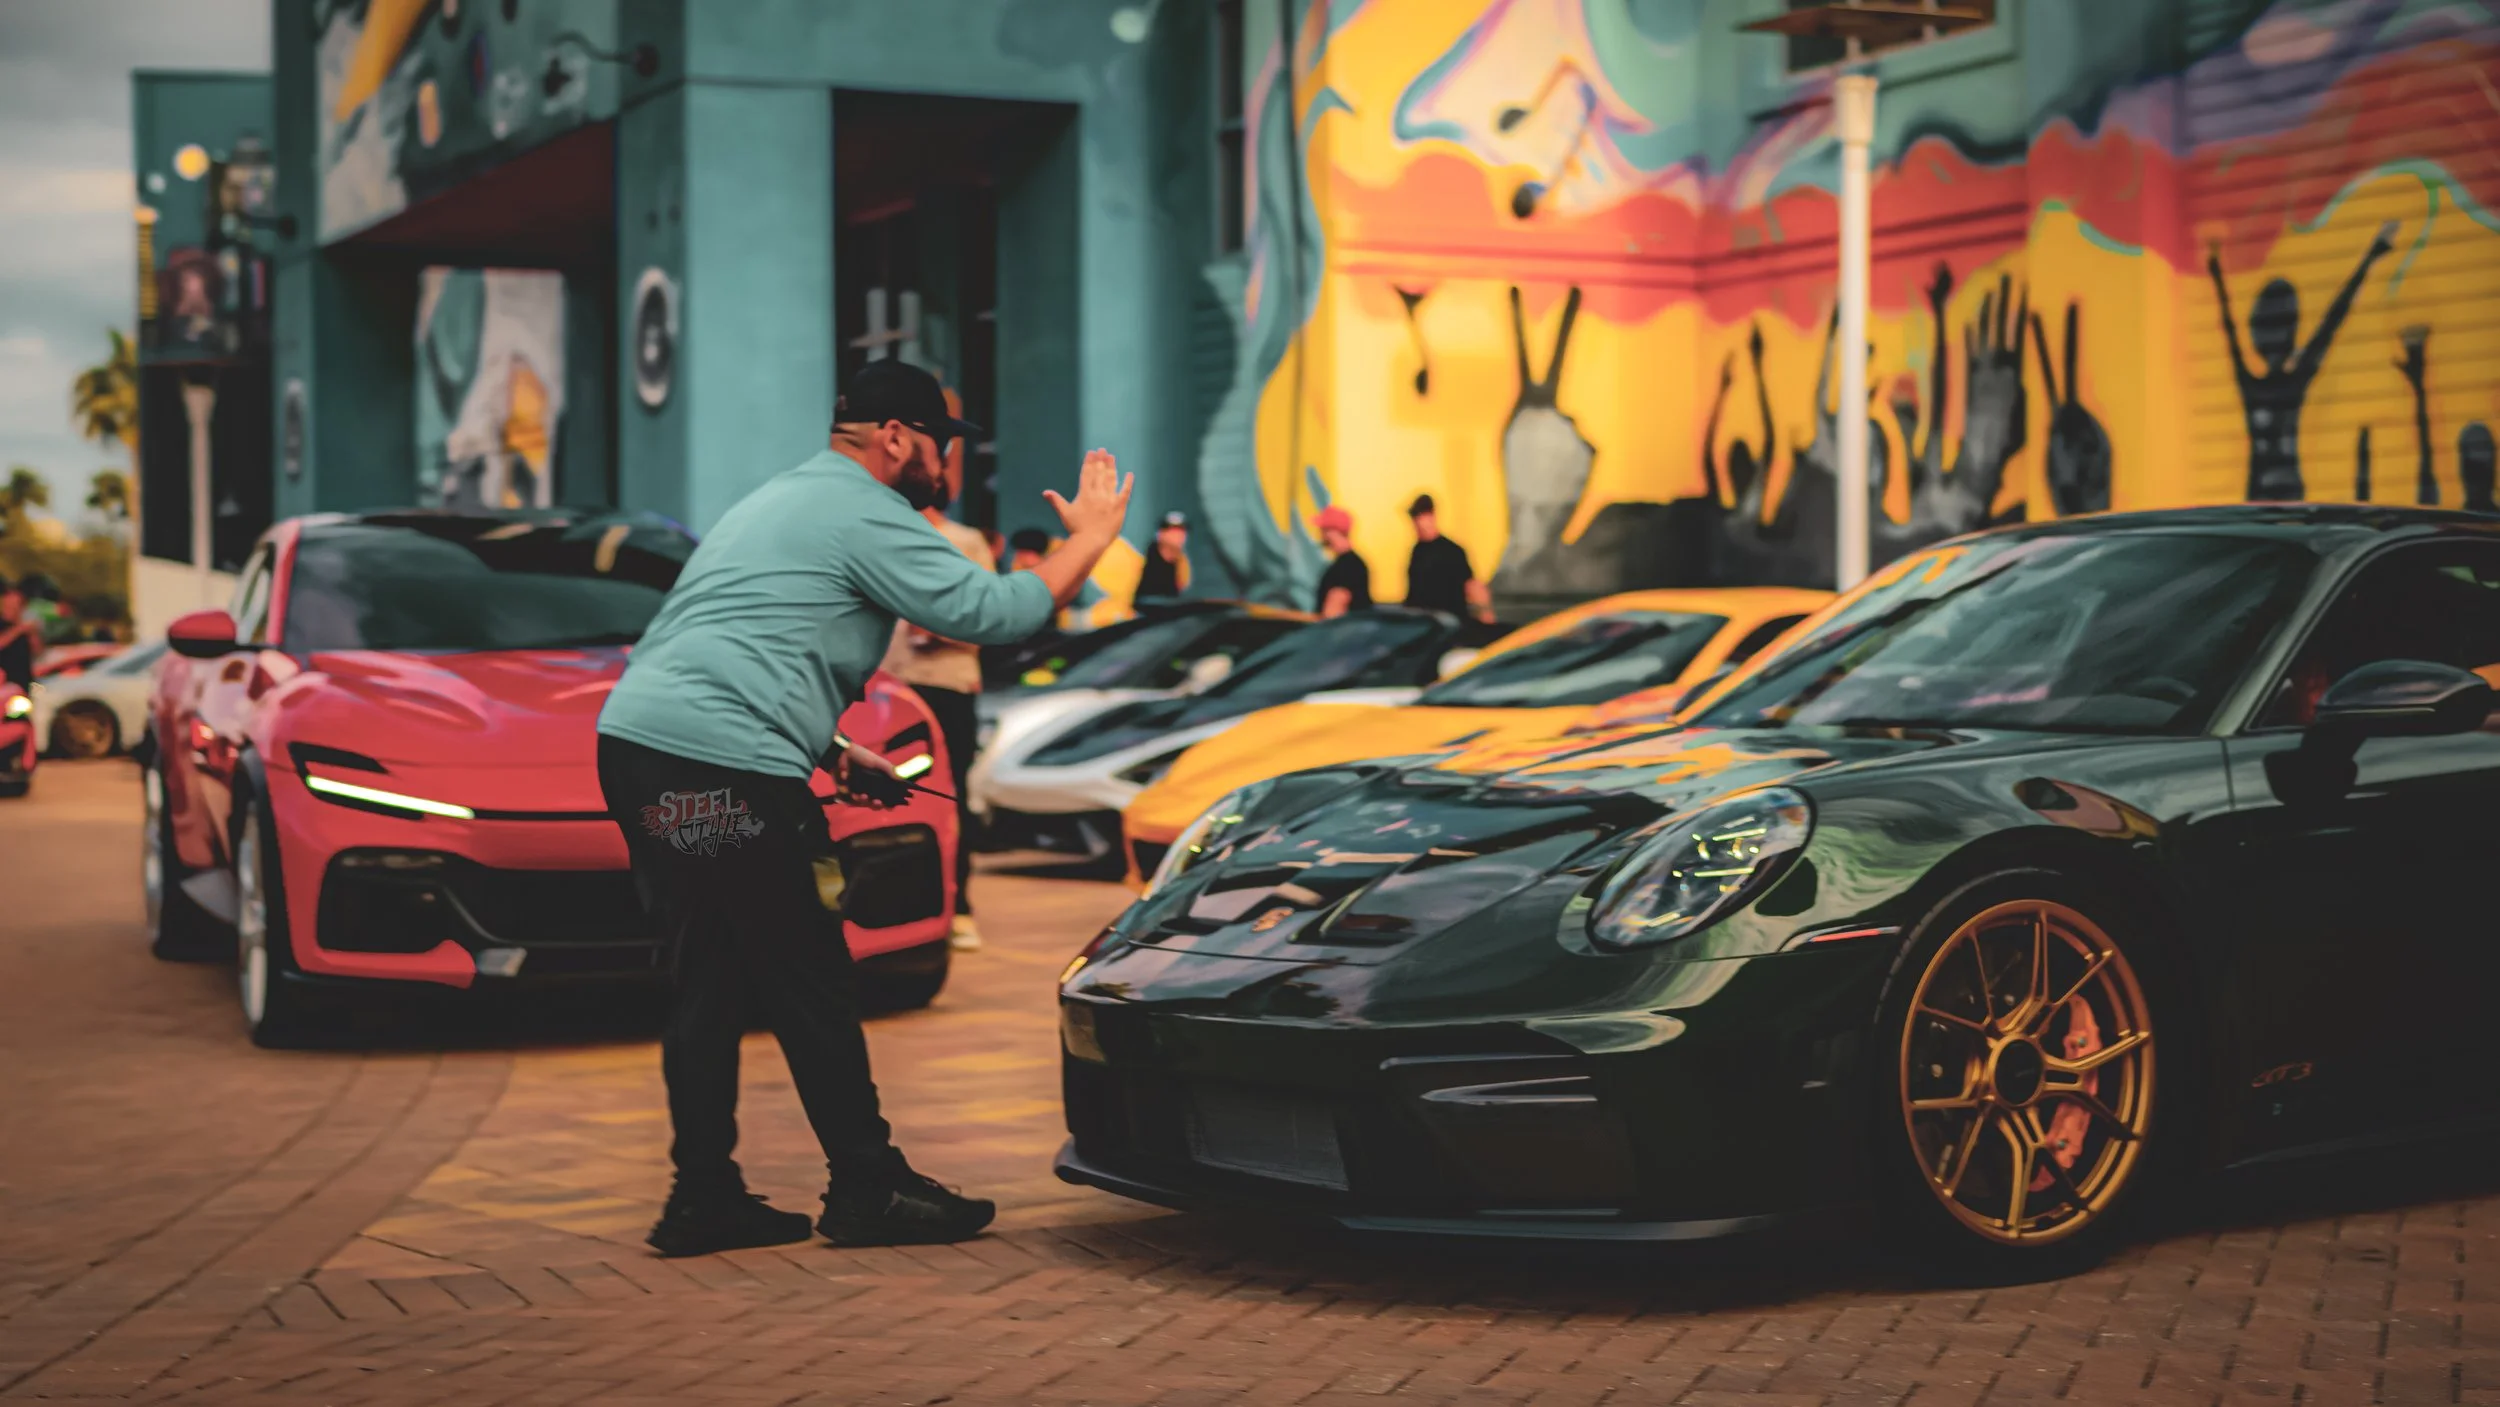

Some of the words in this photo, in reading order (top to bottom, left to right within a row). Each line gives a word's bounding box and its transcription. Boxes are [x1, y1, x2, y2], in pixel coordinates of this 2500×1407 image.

[658, 787, 742, 824] STEEL
[676, 811, 752, 857] STYLE
[2251, 1061, 2313, 1087] GT3
